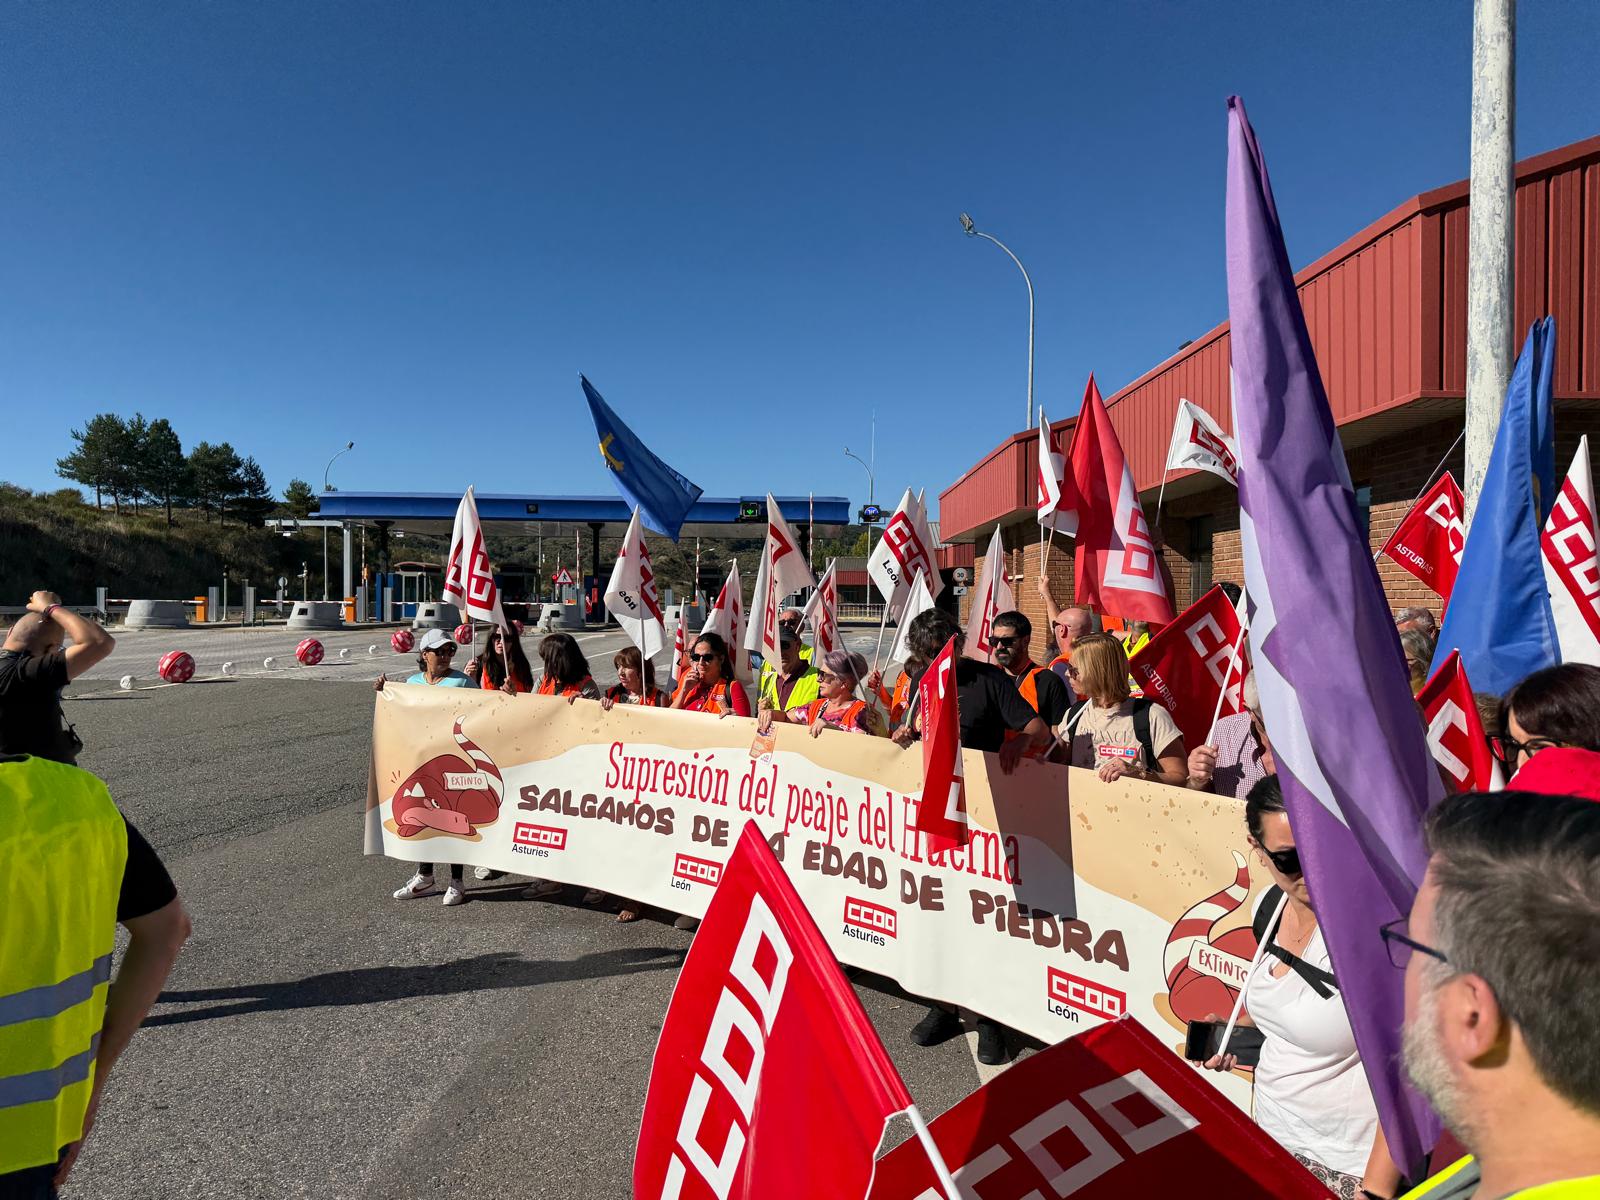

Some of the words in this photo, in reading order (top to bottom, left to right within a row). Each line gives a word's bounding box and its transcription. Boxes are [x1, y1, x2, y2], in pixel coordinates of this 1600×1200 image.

[1394, 543, 1434, 575] ASTURIAS
[1545, 490, 1600, 620] CCO
[882, 559, 901, 588] León
[618, 590, 637, 610] eón
[1140, 663, 1178, 712] ASTURIAS
[605, 741, 729, 806] Supresión
[739, 760, 778, 818] del
[784, 780, 849, 848] peaje
[858, 786, 896, 852] del
[511, 843, 549, 858] Asturies
[516, 826, 564, 847] CCOO
[517, 784, 675, 836] SALGAMOS
[691, 815, 730, 847] DE
[802, 839, 888, 890] EDAD
[900, 868, 945, 911] DE
[670, 876, 691, 892] León
[676, 858, 720, 883] CCOO
[847, 902, 896, 933] CCOO
[842, 924, 886, 947] Asturies
[1047, 998, 1079, 1024] León
[1051, 974, 1121, 1019] CCOO
